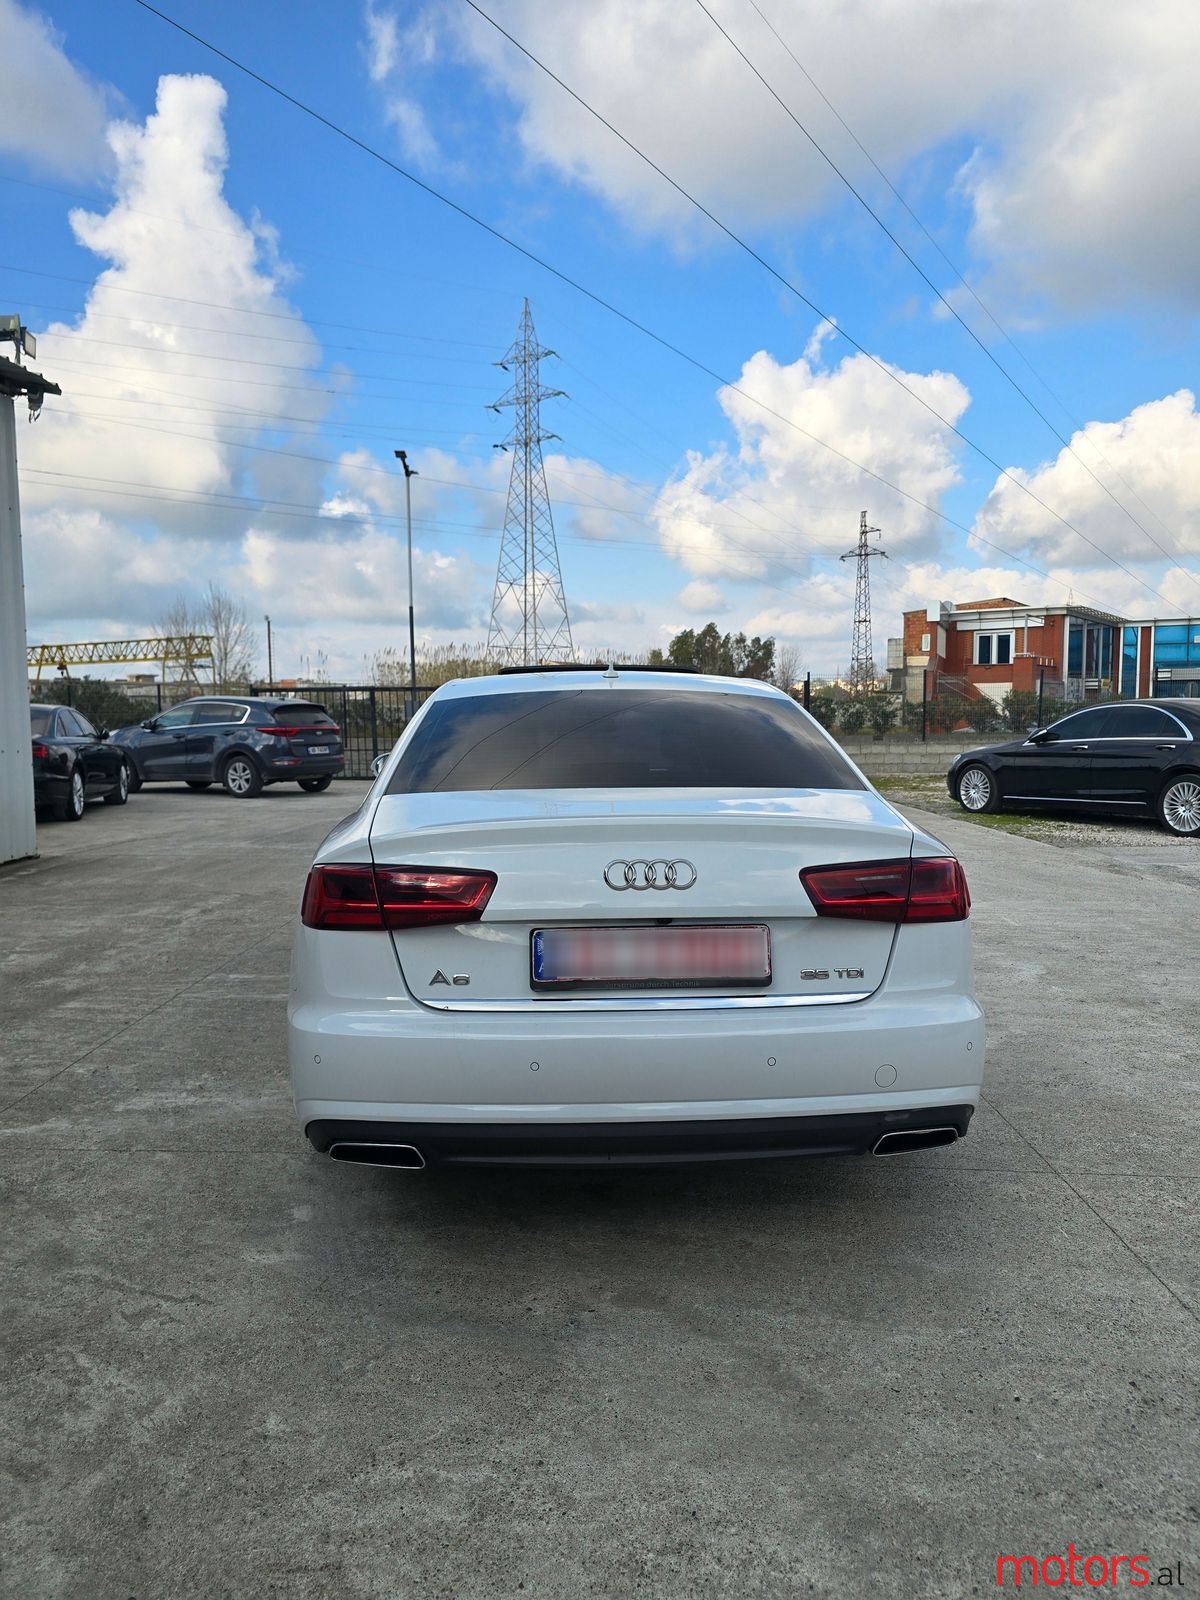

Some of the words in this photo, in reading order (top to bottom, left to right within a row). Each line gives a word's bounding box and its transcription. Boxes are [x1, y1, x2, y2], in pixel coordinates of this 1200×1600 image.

[428, 968, 471, 986] A6
[800, 968, 830, 980] 35
[834, 967, 865, 979] TDI
